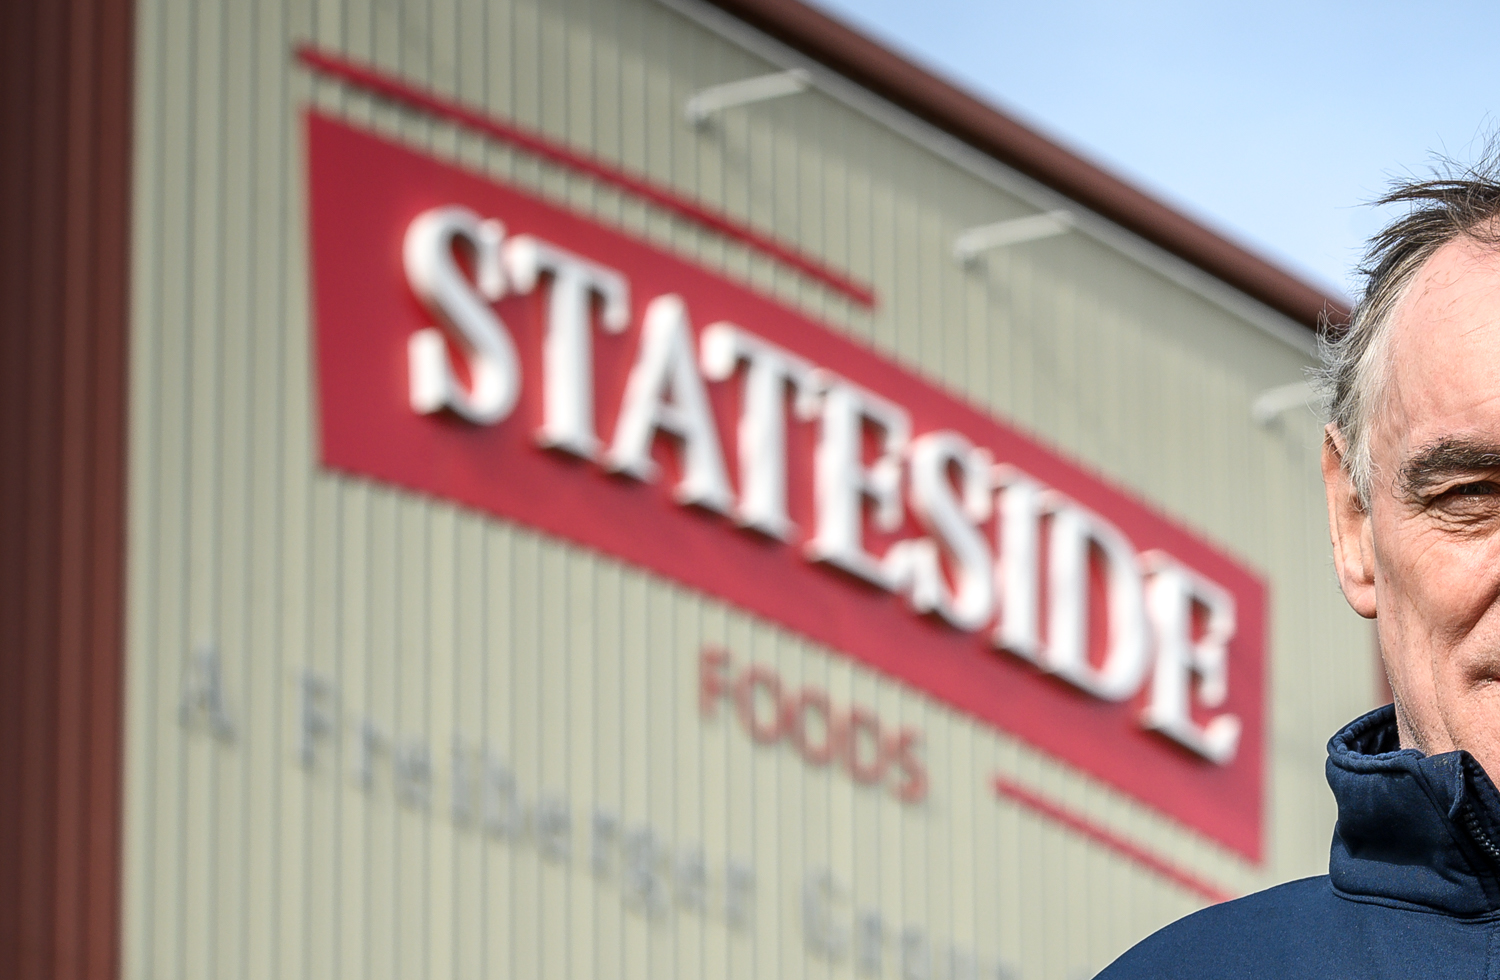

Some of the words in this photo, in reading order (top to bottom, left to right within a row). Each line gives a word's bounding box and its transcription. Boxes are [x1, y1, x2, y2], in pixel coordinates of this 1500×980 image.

[403, 205, 1240, 766] STATESIDE
[177, 645, 237, 746] A
[698, 644, 931, 803] FOODS
